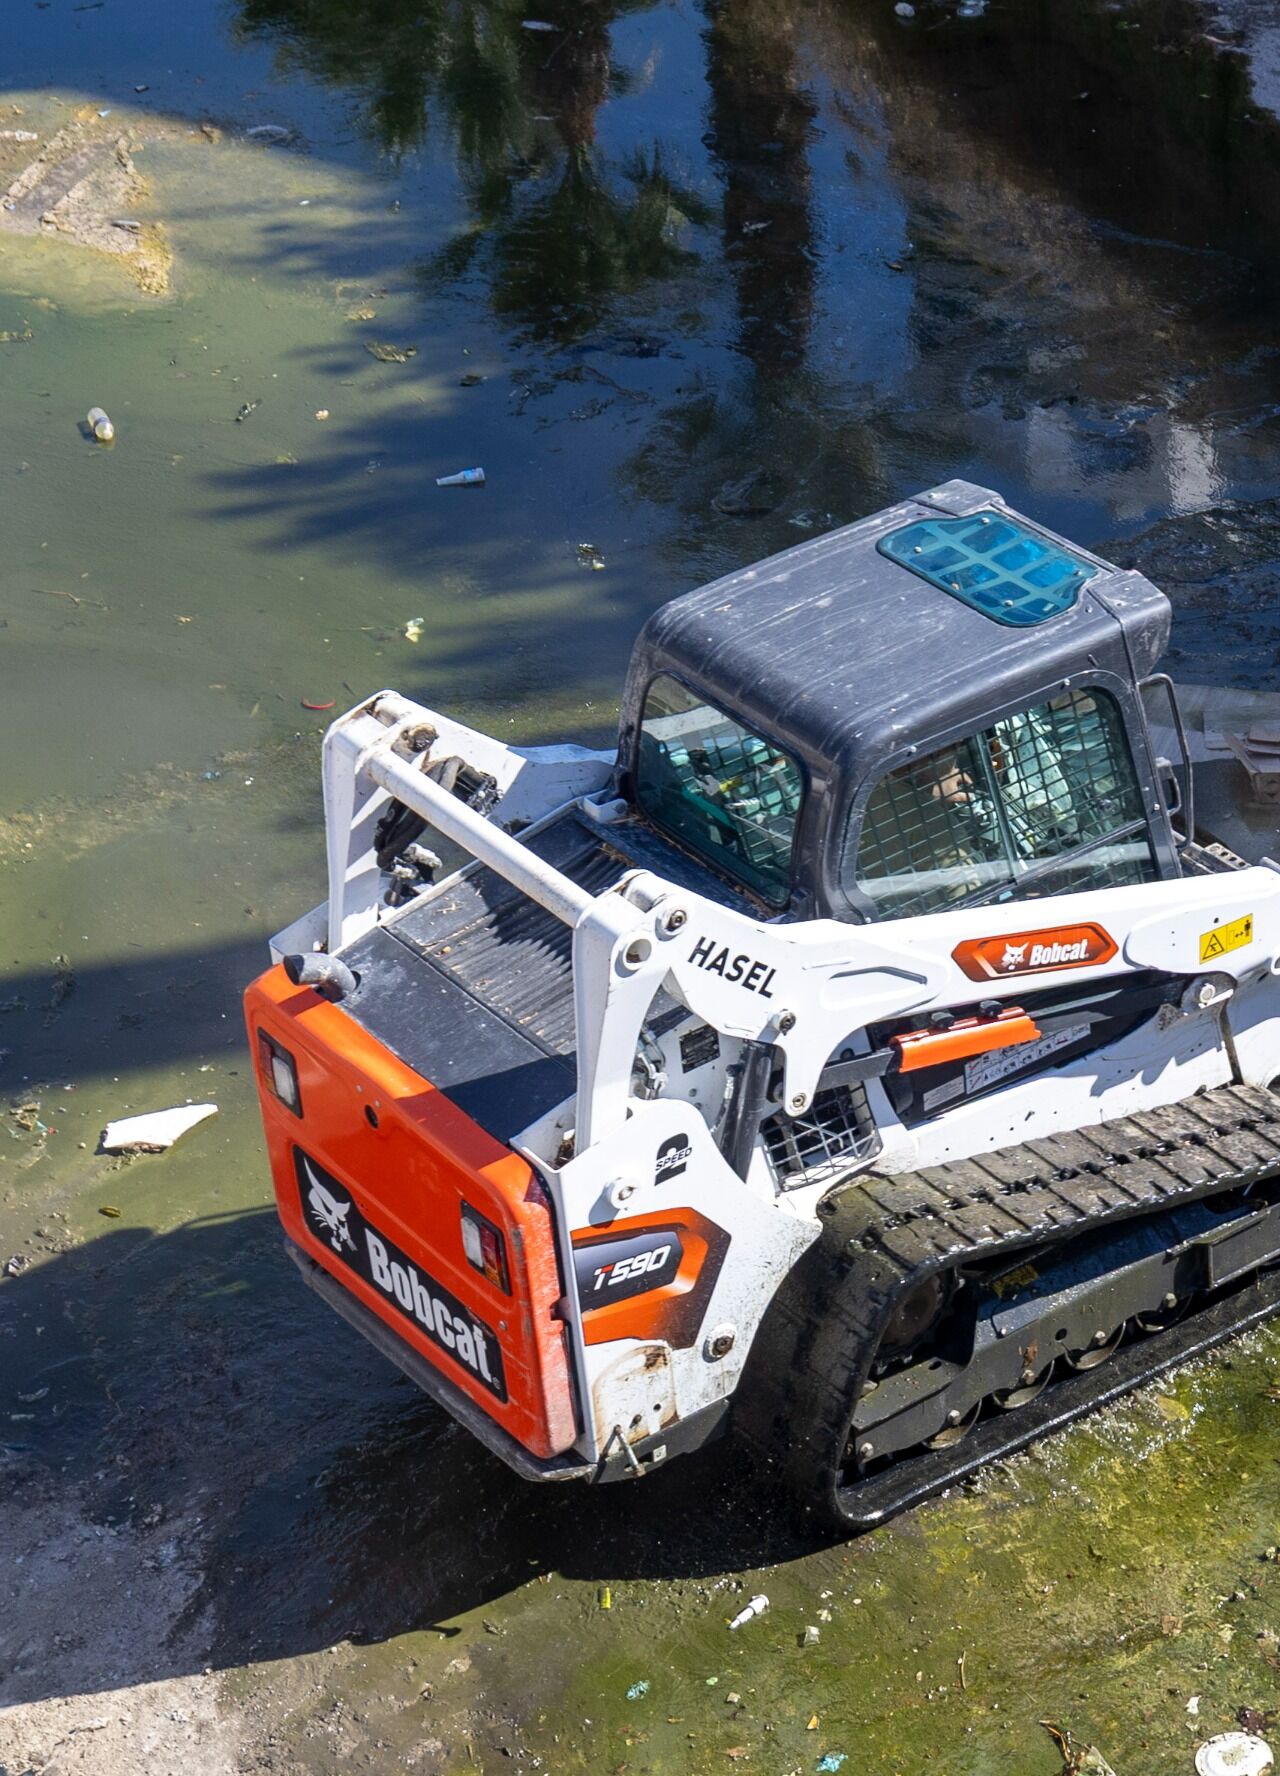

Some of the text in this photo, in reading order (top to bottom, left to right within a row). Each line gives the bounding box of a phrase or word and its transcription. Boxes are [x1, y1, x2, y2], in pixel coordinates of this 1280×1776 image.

[687, 936, 776, 998] HASEL
[1029, 938, 1088, 966] Bobcat
[654, 1132, 689, 1187] 2
[655, 1147, 692, 1171] SPEED
[593, 1245, 671, 1291] T590
[364, 1227, 492, 1383] Bobcat
